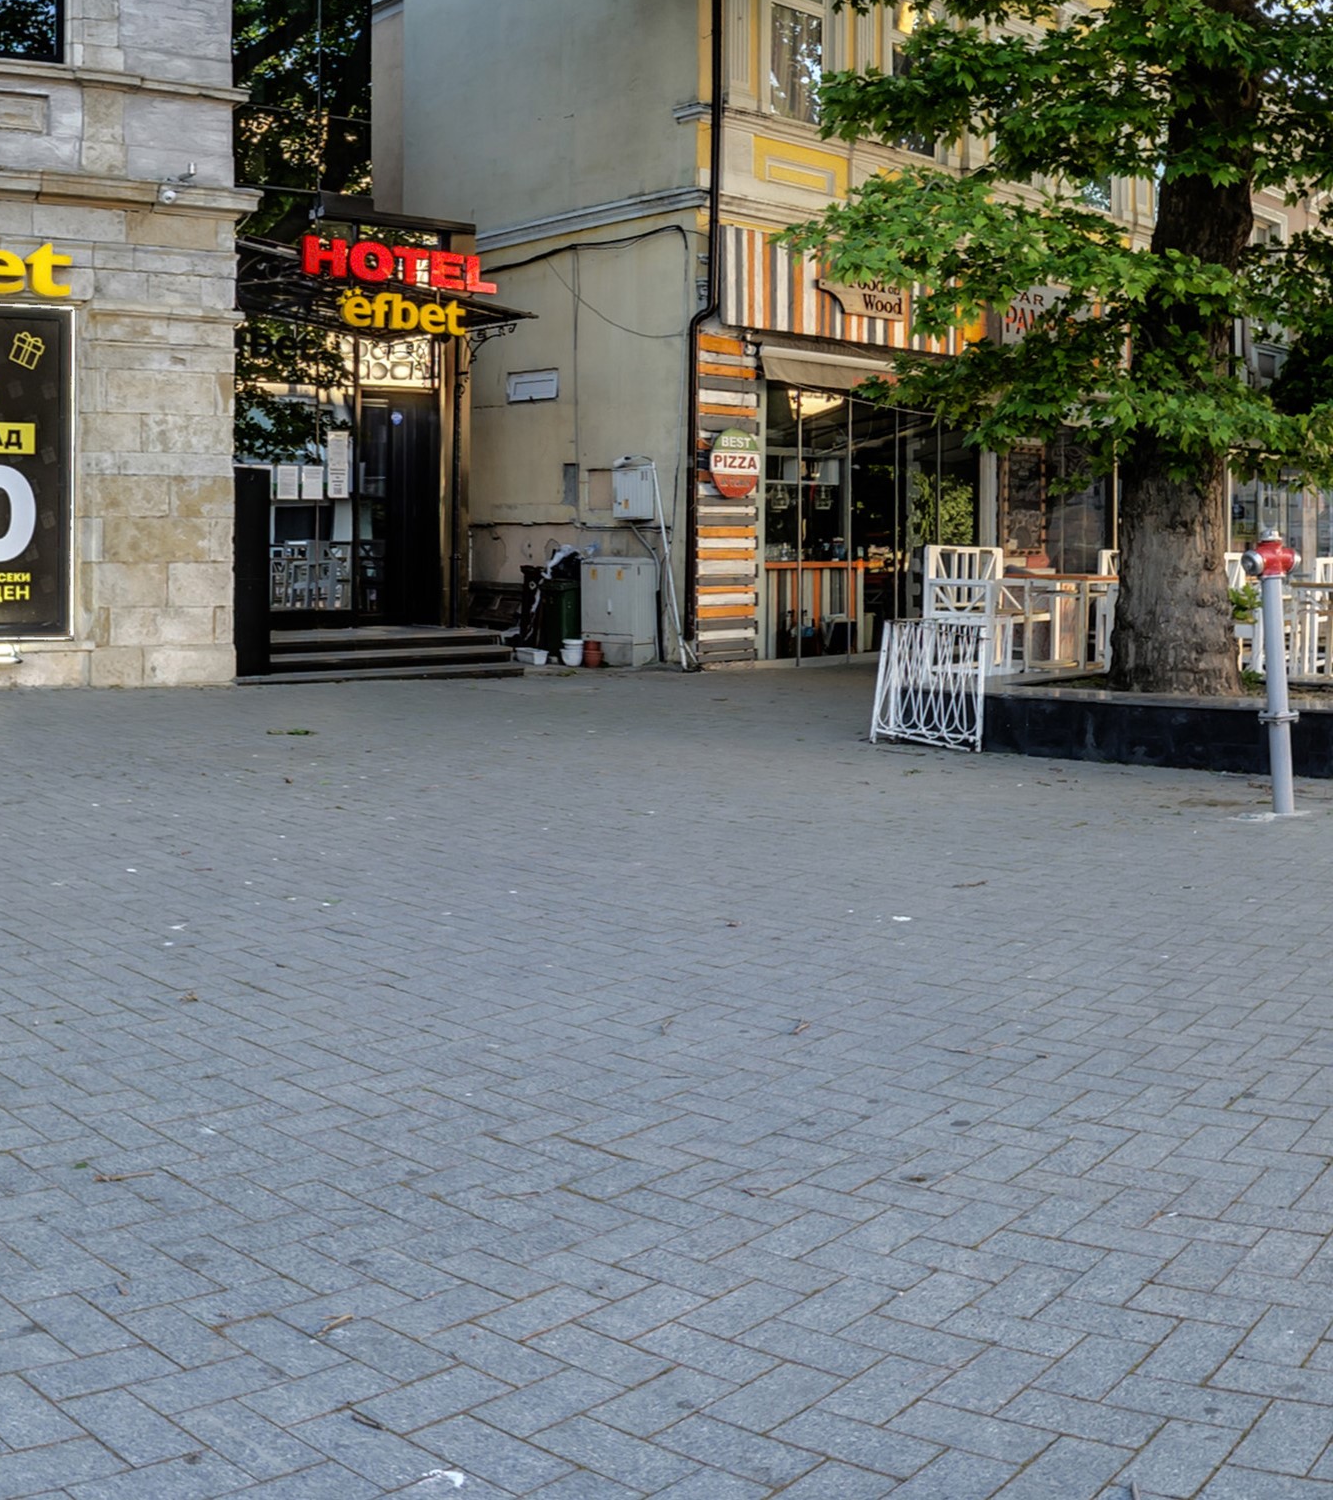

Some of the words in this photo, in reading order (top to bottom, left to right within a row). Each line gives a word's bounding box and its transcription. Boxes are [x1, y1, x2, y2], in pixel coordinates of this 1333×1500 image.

[301, 234, 497, 295] HOTEL
[341, 293, 466, 336] efbet
[863, 293, 903, 315] Wood
[721, 436, 751, 448] BEST
[713, 455, 757, 470] PIZZA
